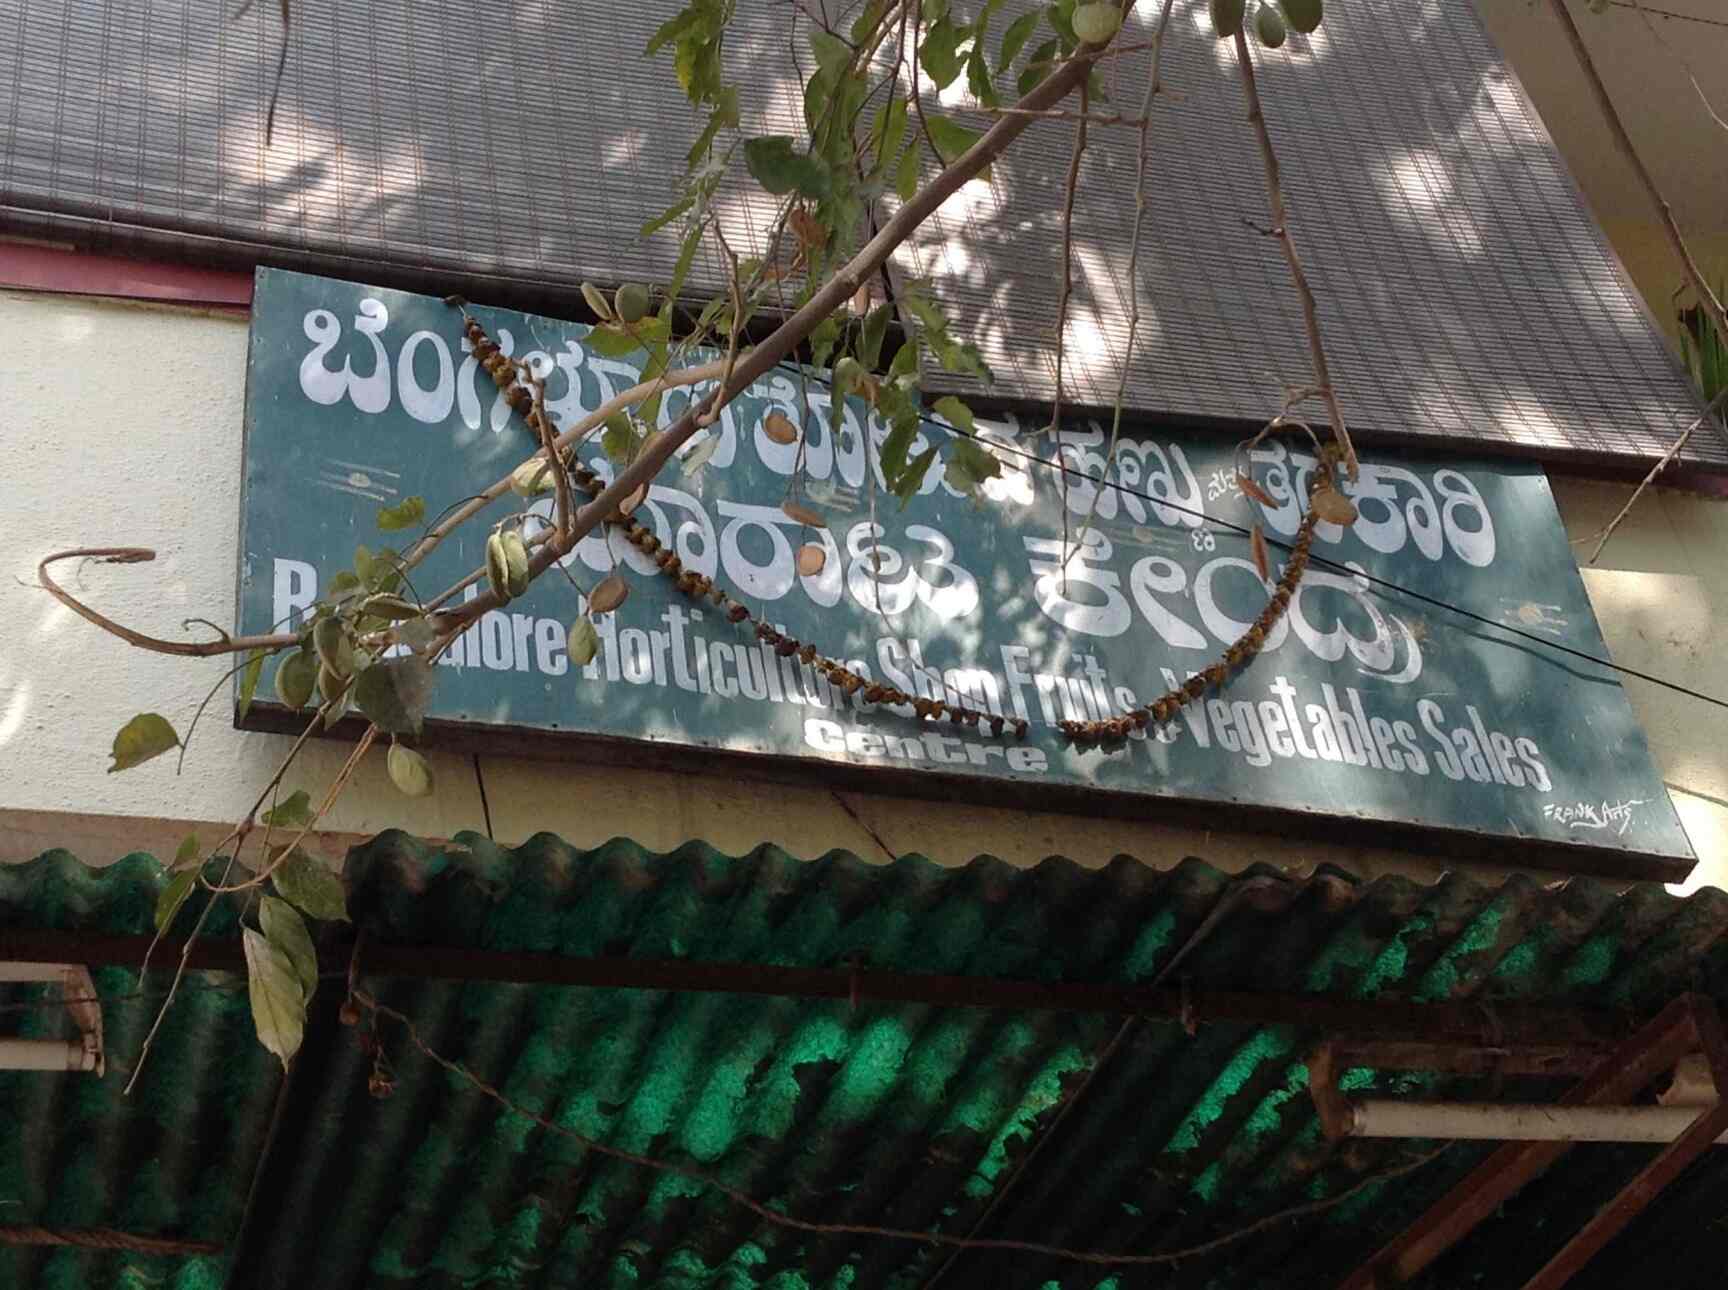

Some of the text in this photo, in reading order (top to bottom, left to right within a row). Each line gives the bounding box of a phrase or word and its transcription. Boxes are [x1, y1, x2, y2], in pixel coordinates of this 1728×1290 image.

[272, 558, 569, 676] Blore
[1160, 666, 1431, 776] Vegetables
[1416, 698, 1553, 793] Sales
[1023, 527, 1423, 684] ಕೇಂದ್ರ
[804, 718, 1049, 772] Centre
